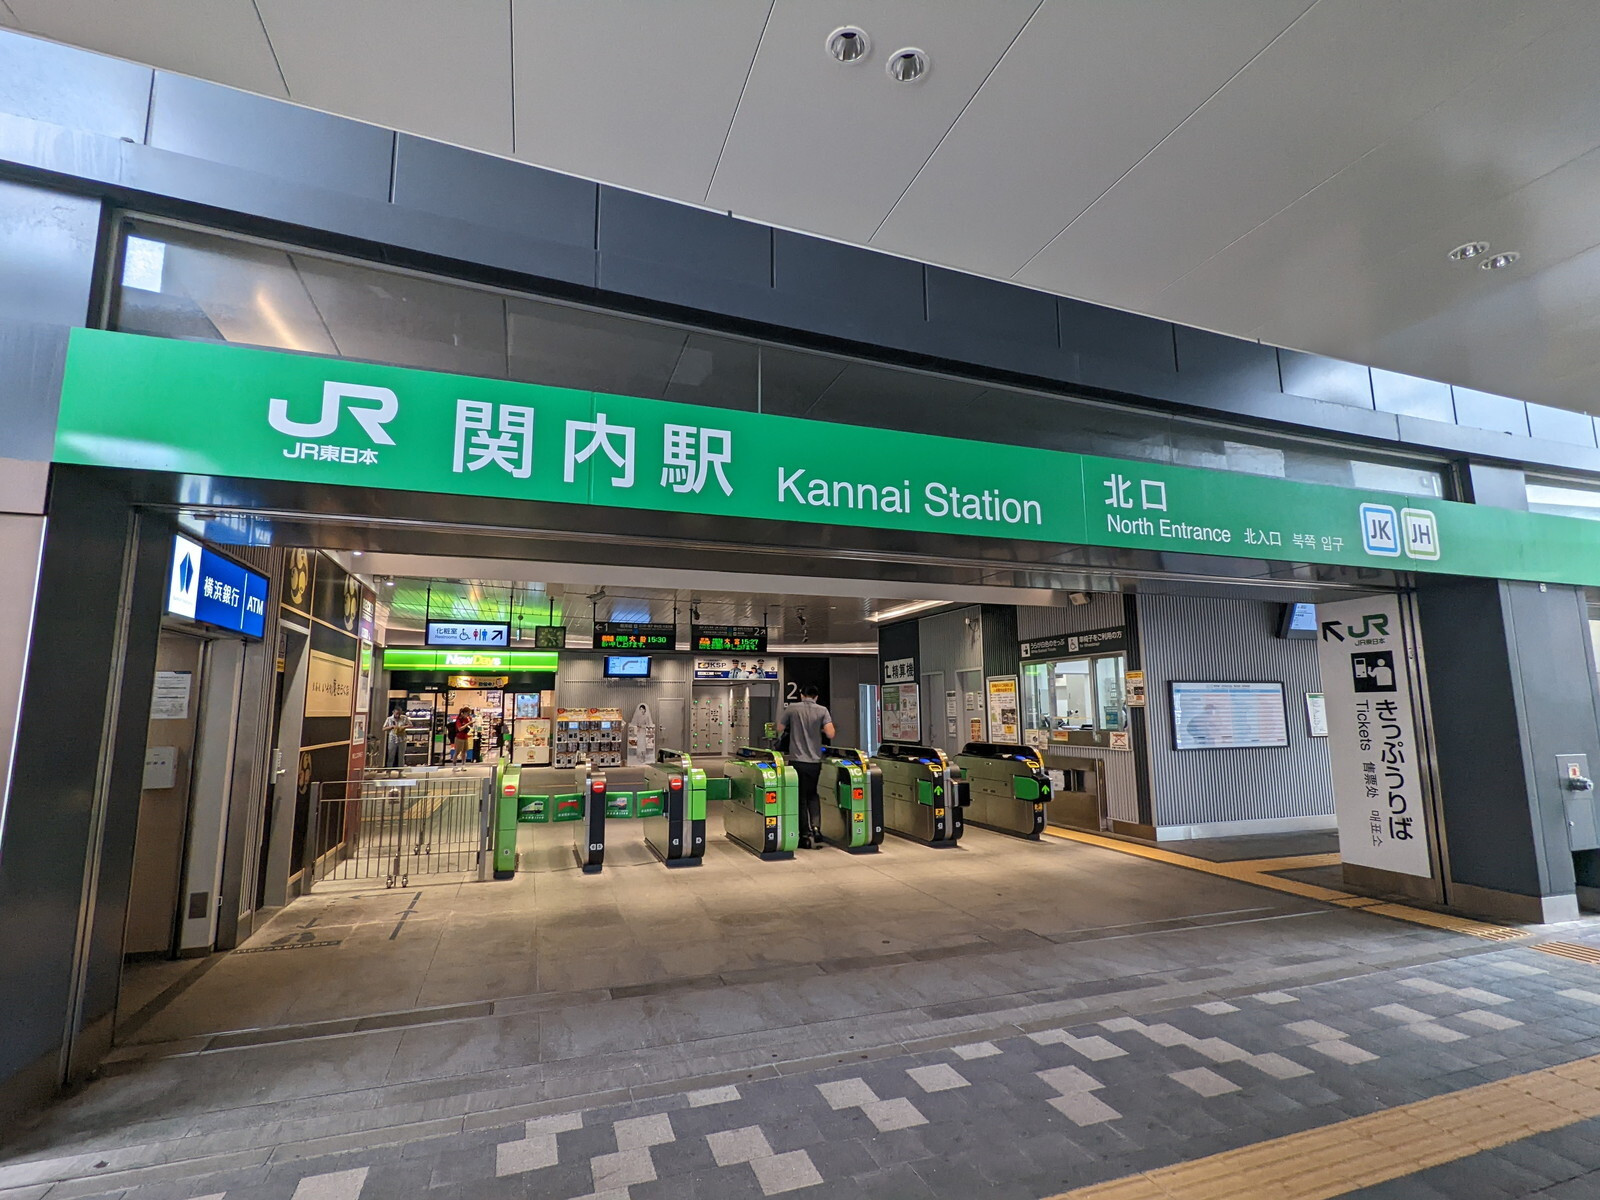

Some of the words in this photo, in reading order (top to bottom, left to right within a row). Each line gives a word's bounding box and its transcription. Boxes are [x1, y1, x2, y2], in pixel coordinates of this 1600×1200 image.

[268, 380, 399, 446] JR
[283, 442, 379, 465] JR東日本
[452, 398, 734, 497] 関内駅
[778, 466, 911, 514] Kannai
[924, 482, 1042, 525] Station
[1103, 473, 1168, 512] 北口
[1107, 514, 1154, 537] North
[1159, 519, 1231, 543] Entrance
[1244, 527, 1282, 547] 北入口
[1370, 519, 1394, 542] JK
[1411, 523, 1432, 545] JH
[1292, 532, 1317, 550] 북쪽
[1321, 536, 1345, 552] 입구
[203, 576, 240, 608] 横浜銀行
[246, 595, 264, 616] ATM
[1347, 613, 1390, 639] JR
[1355, 638, 1386, 647] JR東日本
[445, 654, 502, 666] NewDays
[786, 681, 798, 700] 2
[1355, 699, 1372, 751] Tickets
[1375, 699, 1414, 841] きっぷうりば
